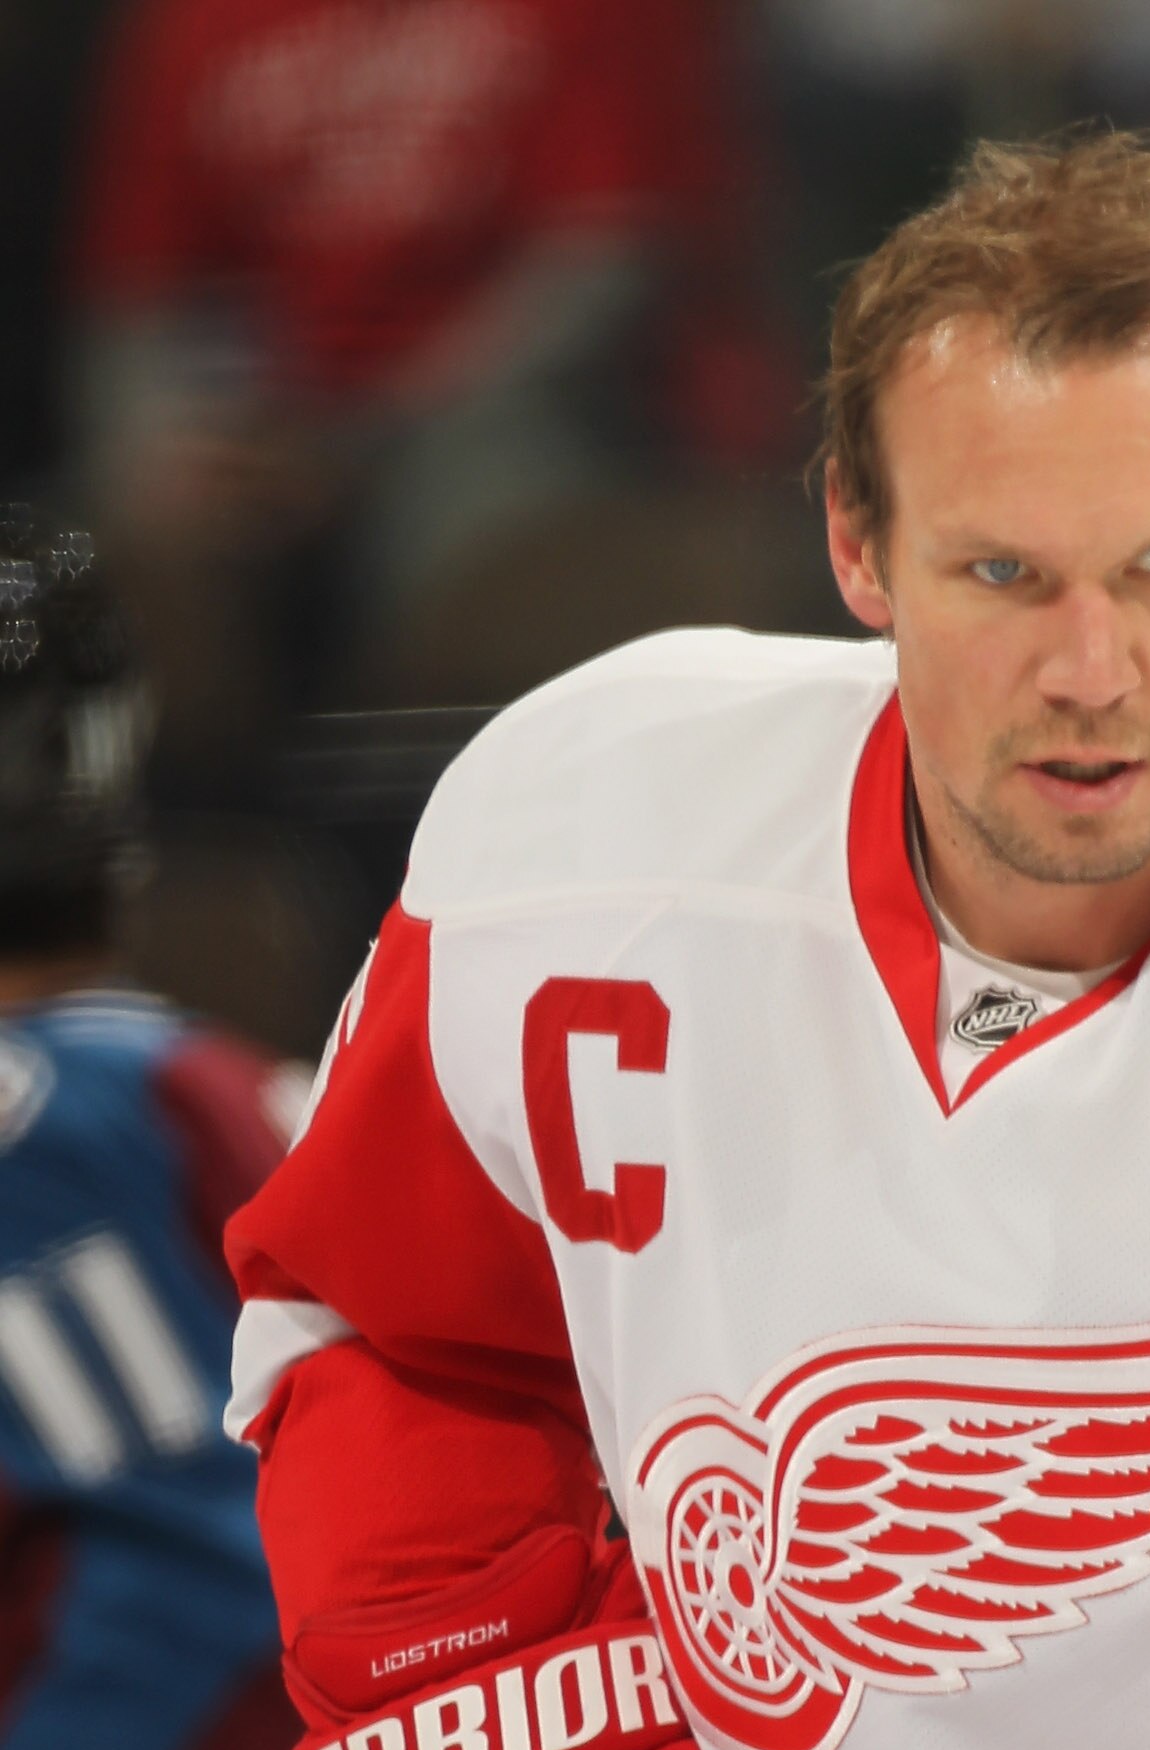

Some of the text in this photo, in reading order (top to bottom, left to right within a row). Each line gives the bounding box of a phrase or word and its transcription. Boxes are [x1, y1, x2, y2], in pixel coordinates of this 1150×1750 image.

[965, 1003, 1025, 1031] NHL
[522, 976, 669, 1254] C
[371, 1619, 509, 1678] LIDSTROM
